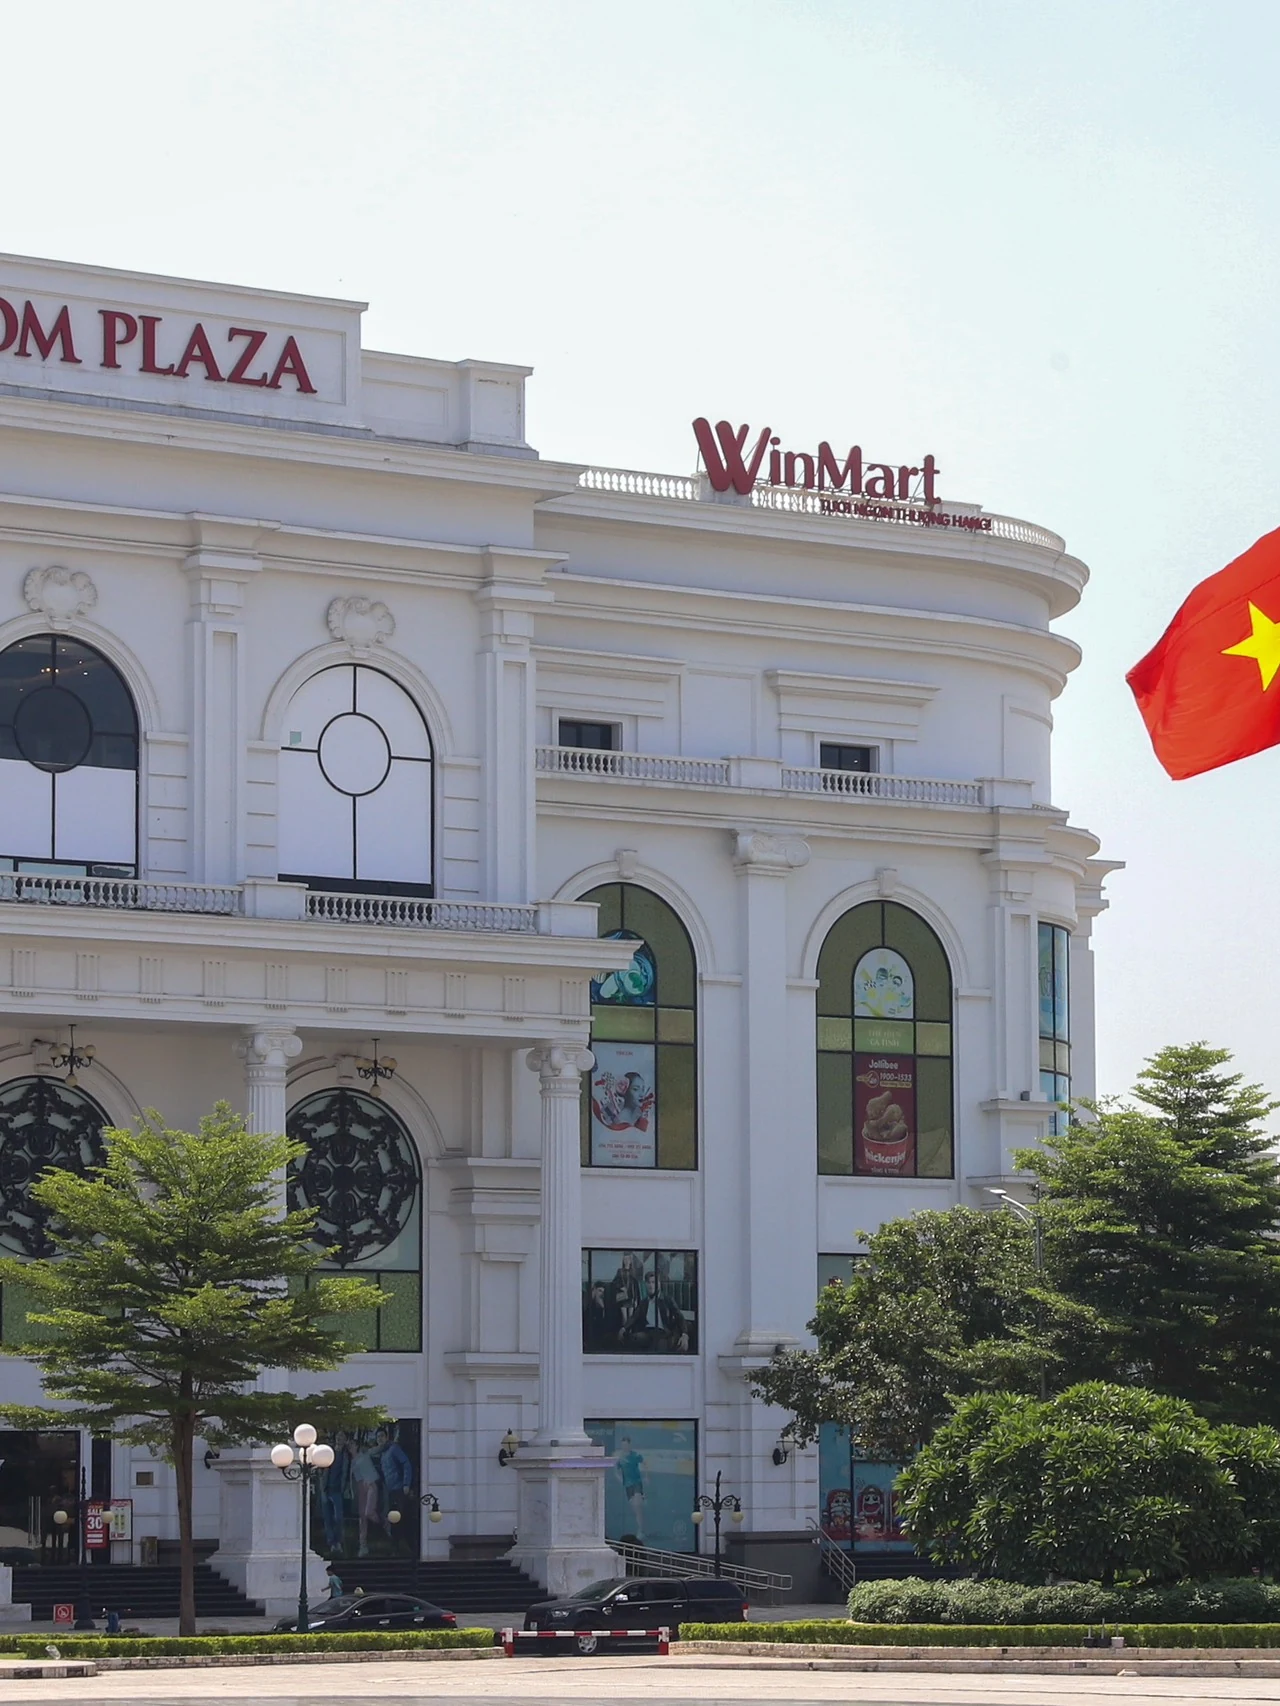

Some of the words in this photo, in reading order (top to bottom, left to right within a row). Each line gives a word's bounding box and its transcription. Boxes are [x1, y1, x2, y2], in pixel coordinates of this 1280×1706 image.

[98, 309, 318, 394] PLAZA
[692, 417, 941, 505] WinMart
[868, 1059, 899, 1070] Jollibee
[87, 1516, 103, 1530] 30
